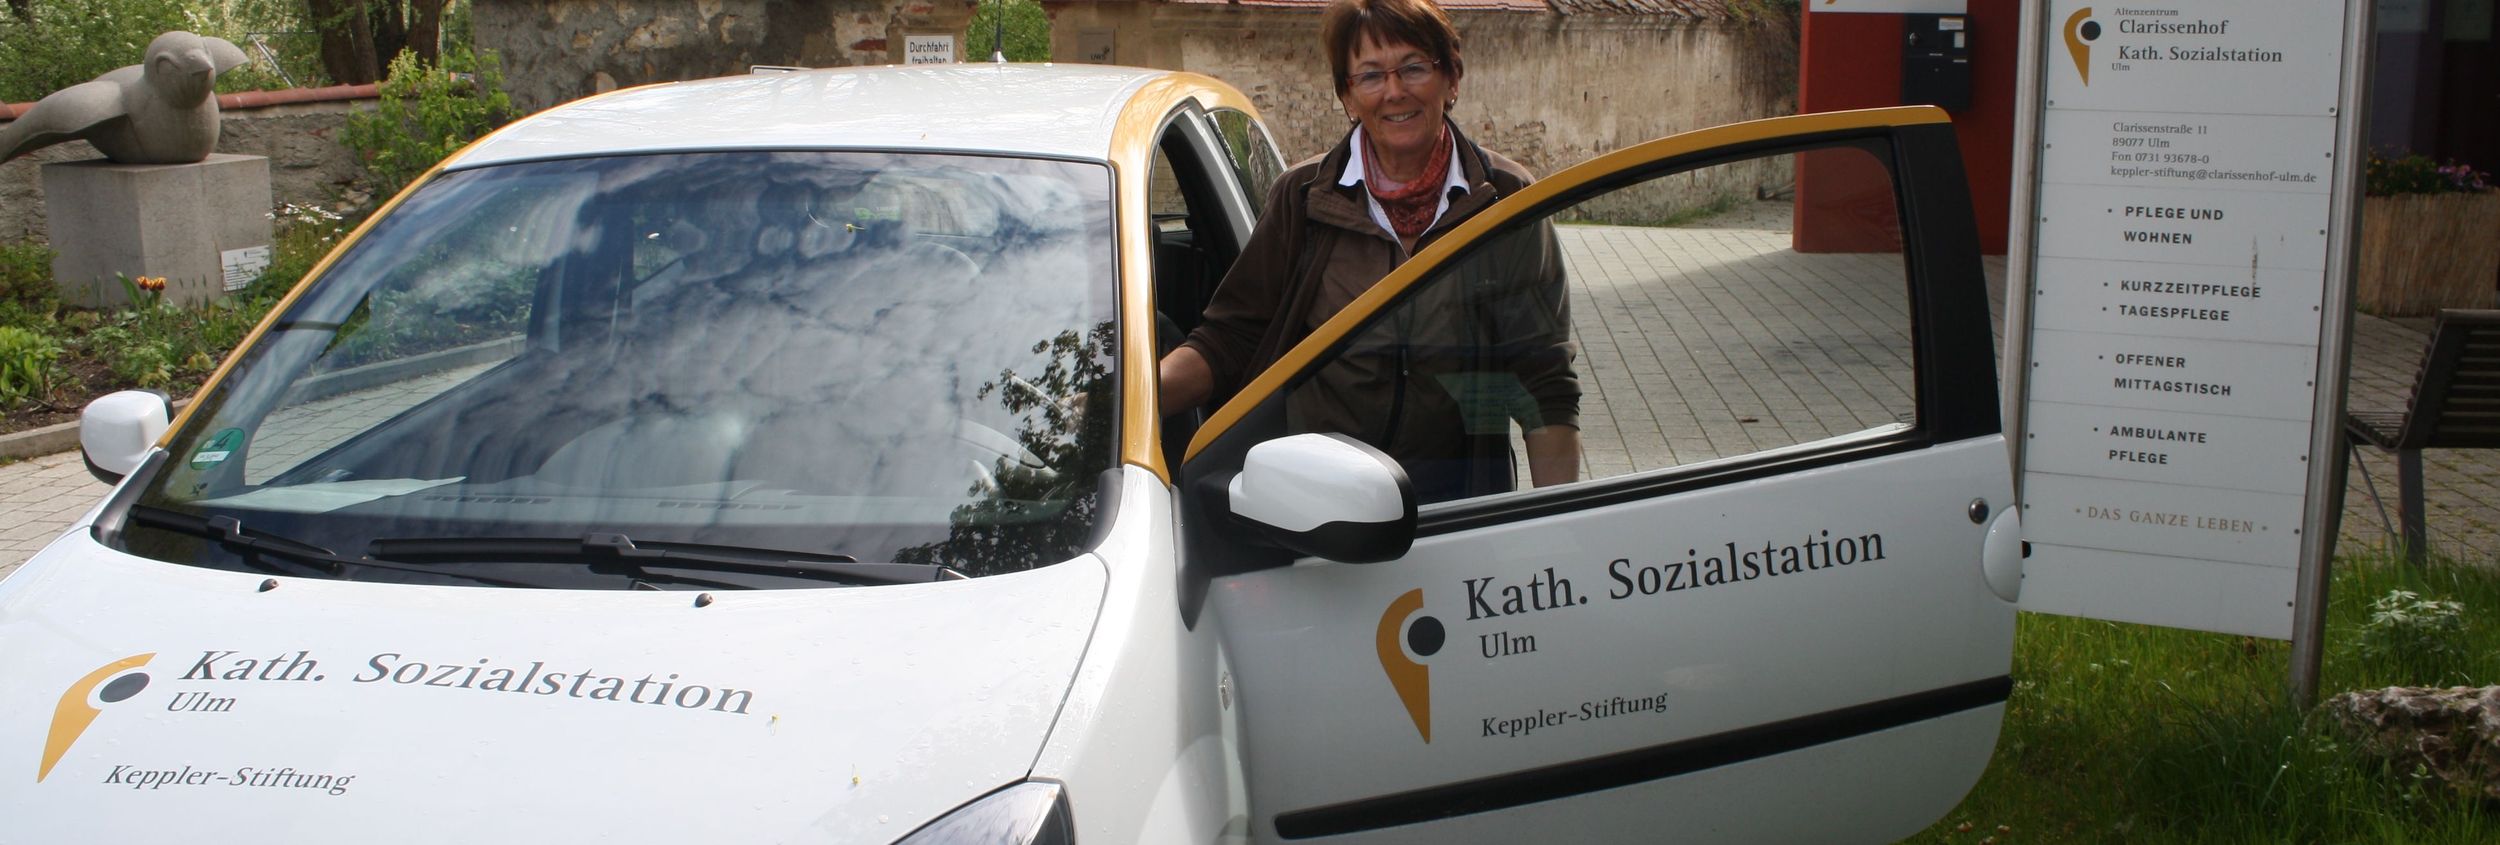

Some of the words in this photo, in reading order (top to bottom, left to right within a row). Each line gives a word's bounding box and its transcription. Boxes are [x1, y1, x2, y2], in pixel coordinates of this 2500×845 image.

[2114, 7, 2179, 16] Altenzentrum
[2119, 19, 2229, 35] Clarissenhof
[910, 41, 949, 53] Durchfahrt
[2119, 46, 2163, 60] Kath.
[2169, 47, 2282, 62] Sozialstation
[2112, 63, 2130, 71] Ulm
[2113, 122, 2193, 135] Clarissenstraße
[2198, 125, 2207, 135] 11
[2112, 137, 2144, 148] 89077
[2148, 138, 2170, 148] Ulm
[2111, 151, 2132, 162] Fon
[2135, 152, 2159, 163] 0731
[2164, 153, 2209, 164] 93678-0
[2110, 165, 2317, 184] keppler-stiftung@clarissenhof-ulm.de
[2125, 206, 2185, 219] PFLEGE
[2191, 208, 2223, 220] UND
[2124, 230, 2192, 244] WOHNEN
[2121, 280, 2261, 298] KURZZEITPFLEGE
[2119, 304, 2230, 321] TAGESPFLEGE
[2115, 353, 2185, 368] OFFENER
[2114, 377, 2231, 396] MITTAGSTISCH
[2110, 425, 2206, 443] AMBULANTE
[2109, 449, 2168, 464] PFLEGE
[2088, 506, 2121, 521] DAS
[2129, 509, 2188, 527] GANZE
[2197, 515, 2254, 533] LEBEN
[1462, 565, 1588, 621] Kath.
[1608, 529, 1886, 601] Sozialstation
[1479, 630, 1537, 659] Ulm
[177, 650, 326, 682] Kath.
[352, 652, 754, 715] Sozialstation
[167, 691, 237, 713] Ulm
[1481, 692, 1668, 738] Keppler-Stiftung
[102, 765, 357, 796] Keppler-Stiftung
